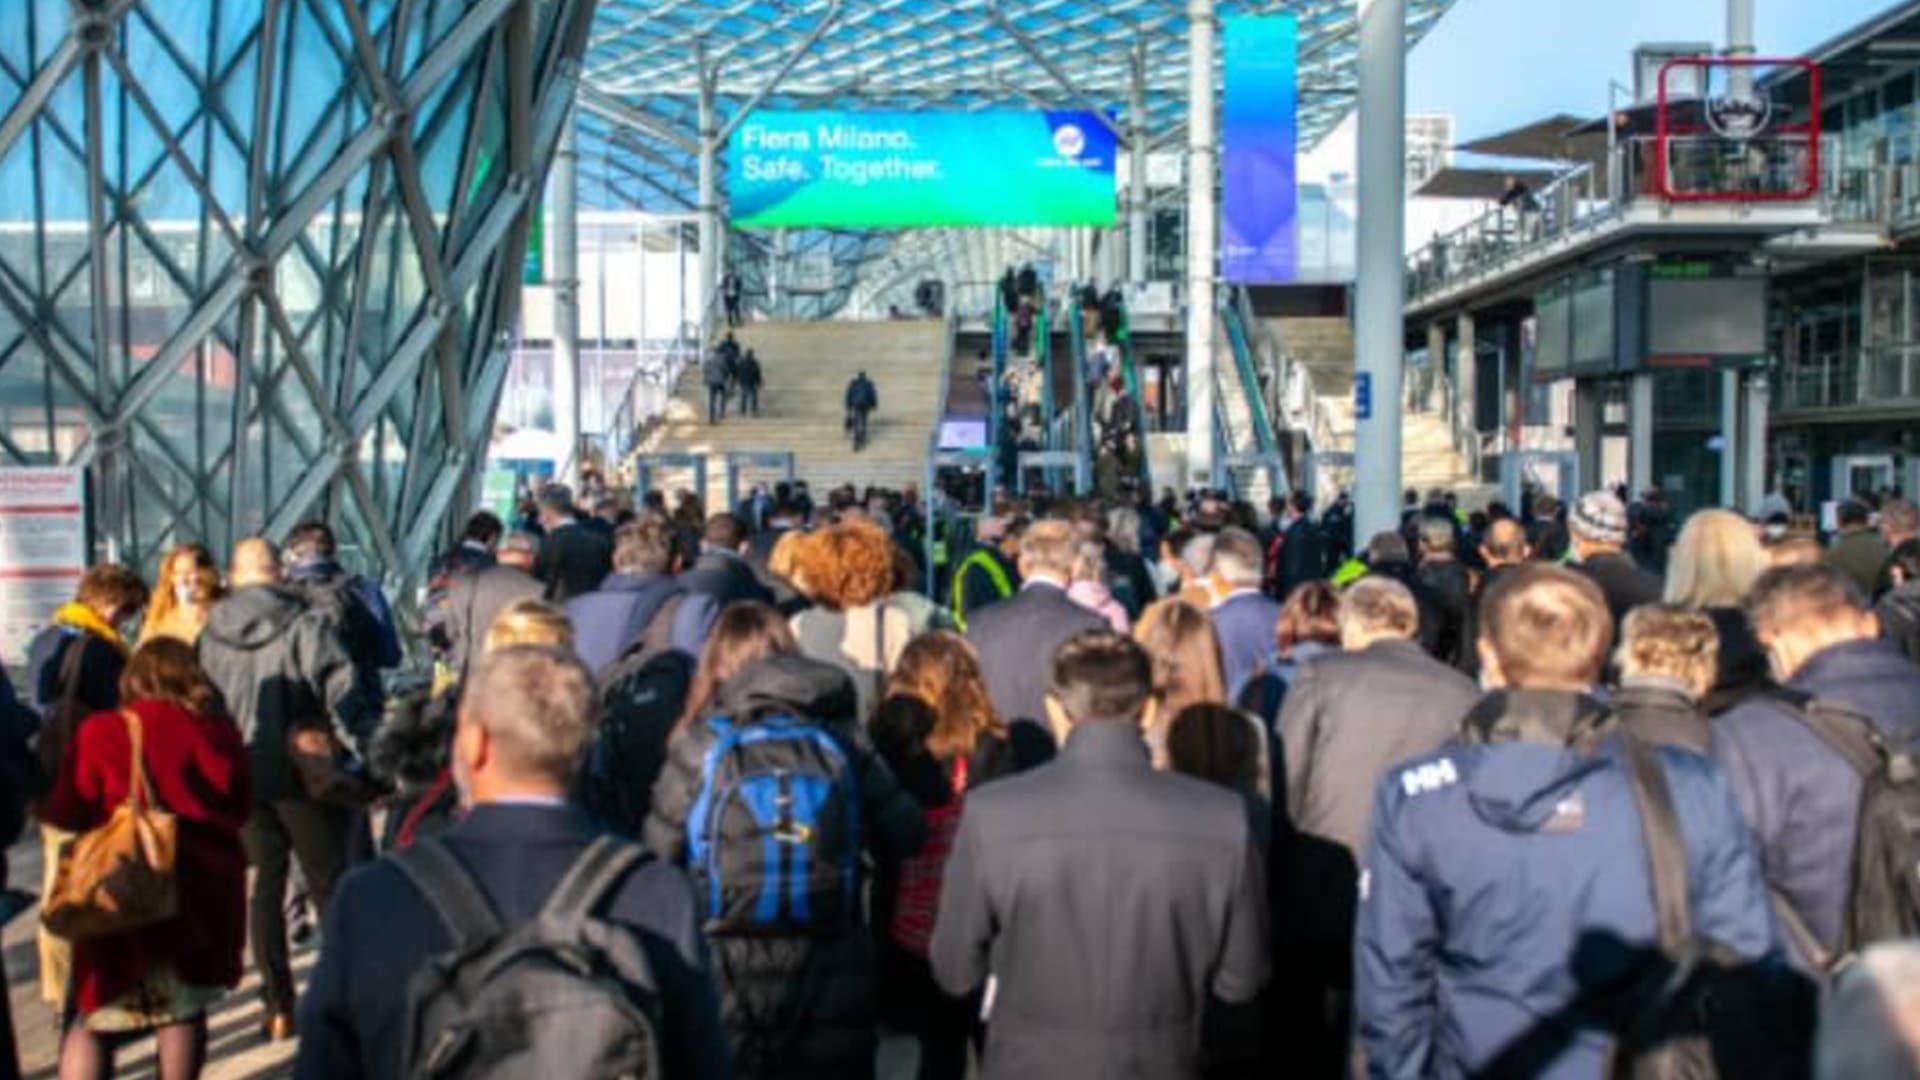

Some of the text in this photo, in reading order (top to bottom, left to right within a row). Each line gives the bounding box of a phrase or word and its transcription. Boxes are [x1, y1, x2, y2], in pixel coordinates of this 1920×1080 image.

[742, 125, 914, 150] Fiera Milano.
[743, 154, 942, 185] Safe. Together.
